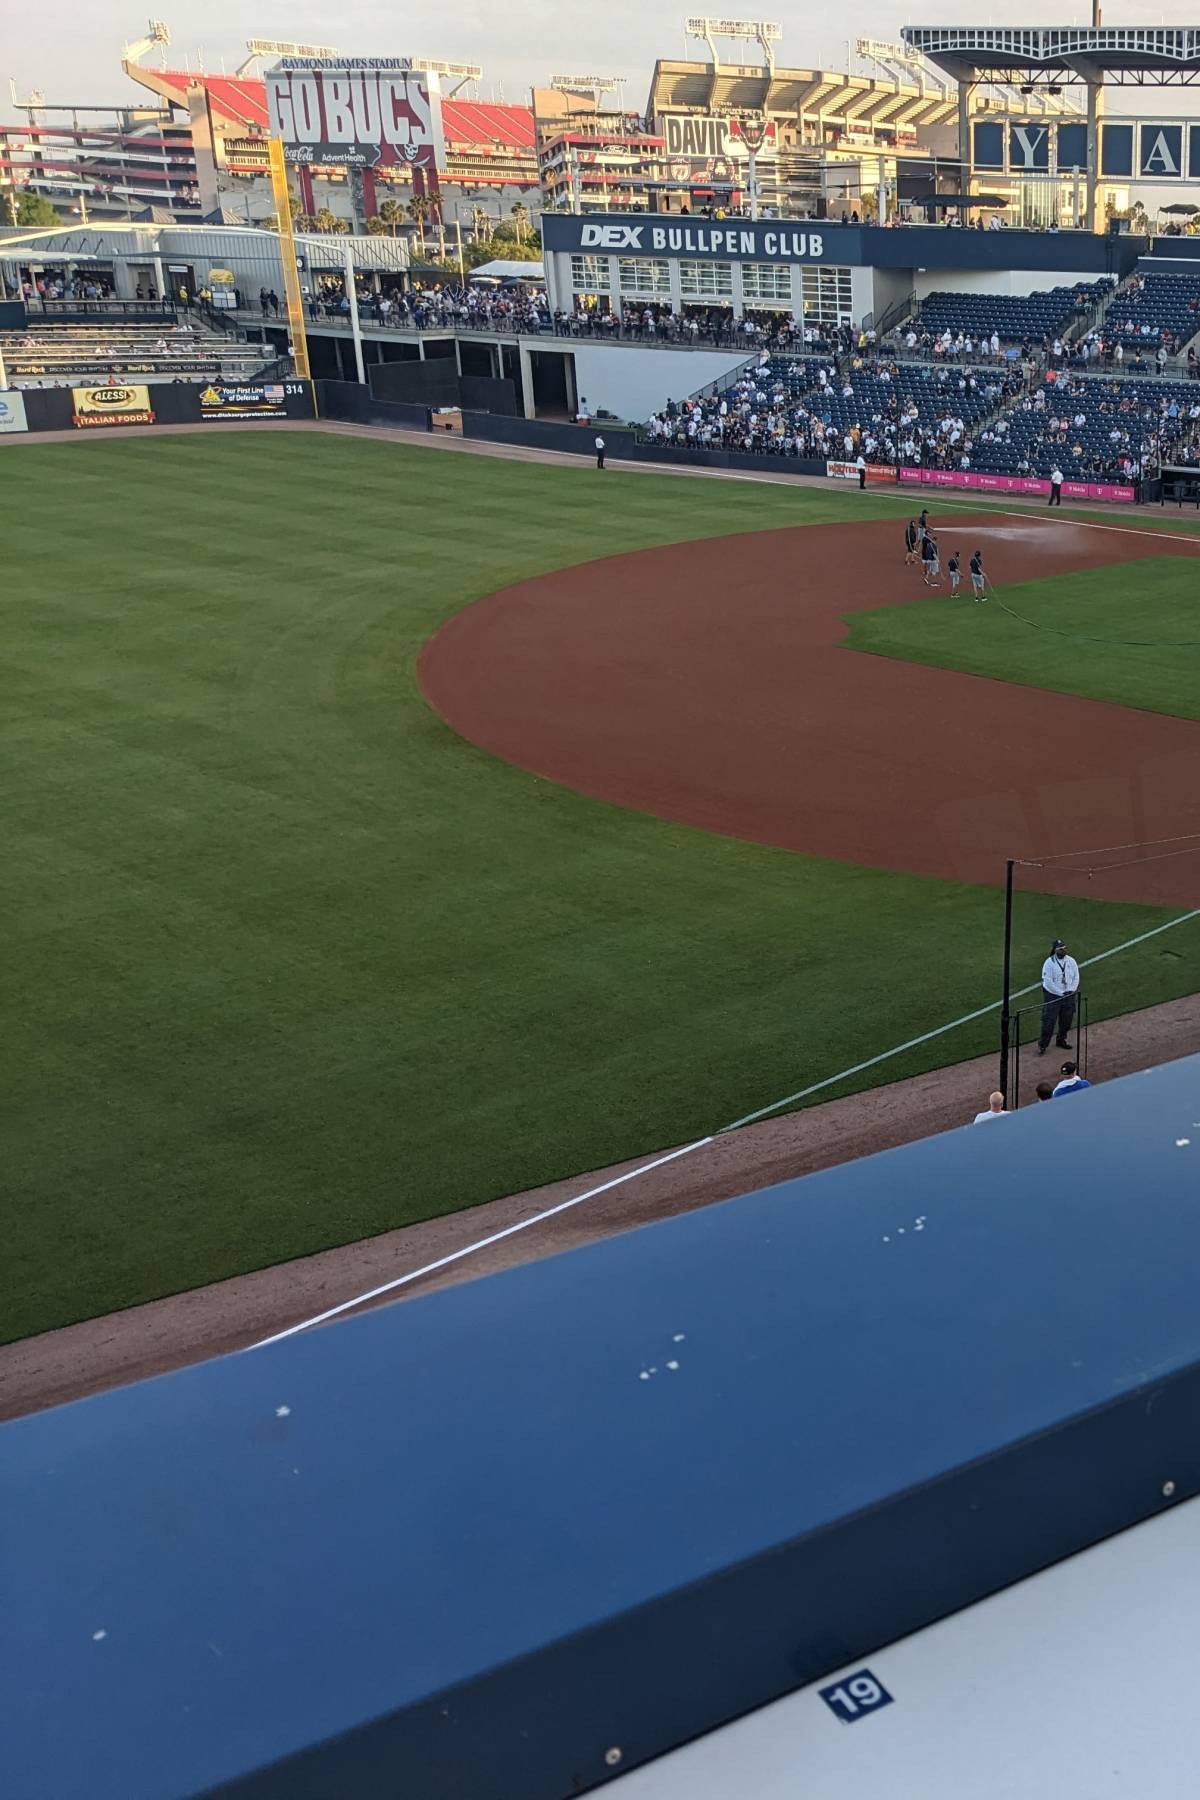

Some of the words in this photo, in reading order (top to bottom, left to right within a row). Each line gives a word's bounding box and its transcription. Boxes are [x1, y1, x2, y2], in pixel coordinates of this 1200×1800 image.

[282, 58, 333, 69] RAYMOND
[334, 58, 366, 69] JAMES
[368, 58, 413, 70] STADIUM
[265, 71, 322, 143] GO
[322, 71, 434, 145] BUCS
[668, 118, 729, 156] DAVID
[322, 153, 367, 162] AdventHealth
[580, 224, 645, 248] DEX
[653, 227, 755, 255] BULLPEN
[765, 233, 824, 257] CLUB
[286, 385, 303, 394] 314
[80, 416, 115, 424] ITALIAN
[118, 414, 149, 422] FOODS
[829, 1677, 881, 1713] 19
